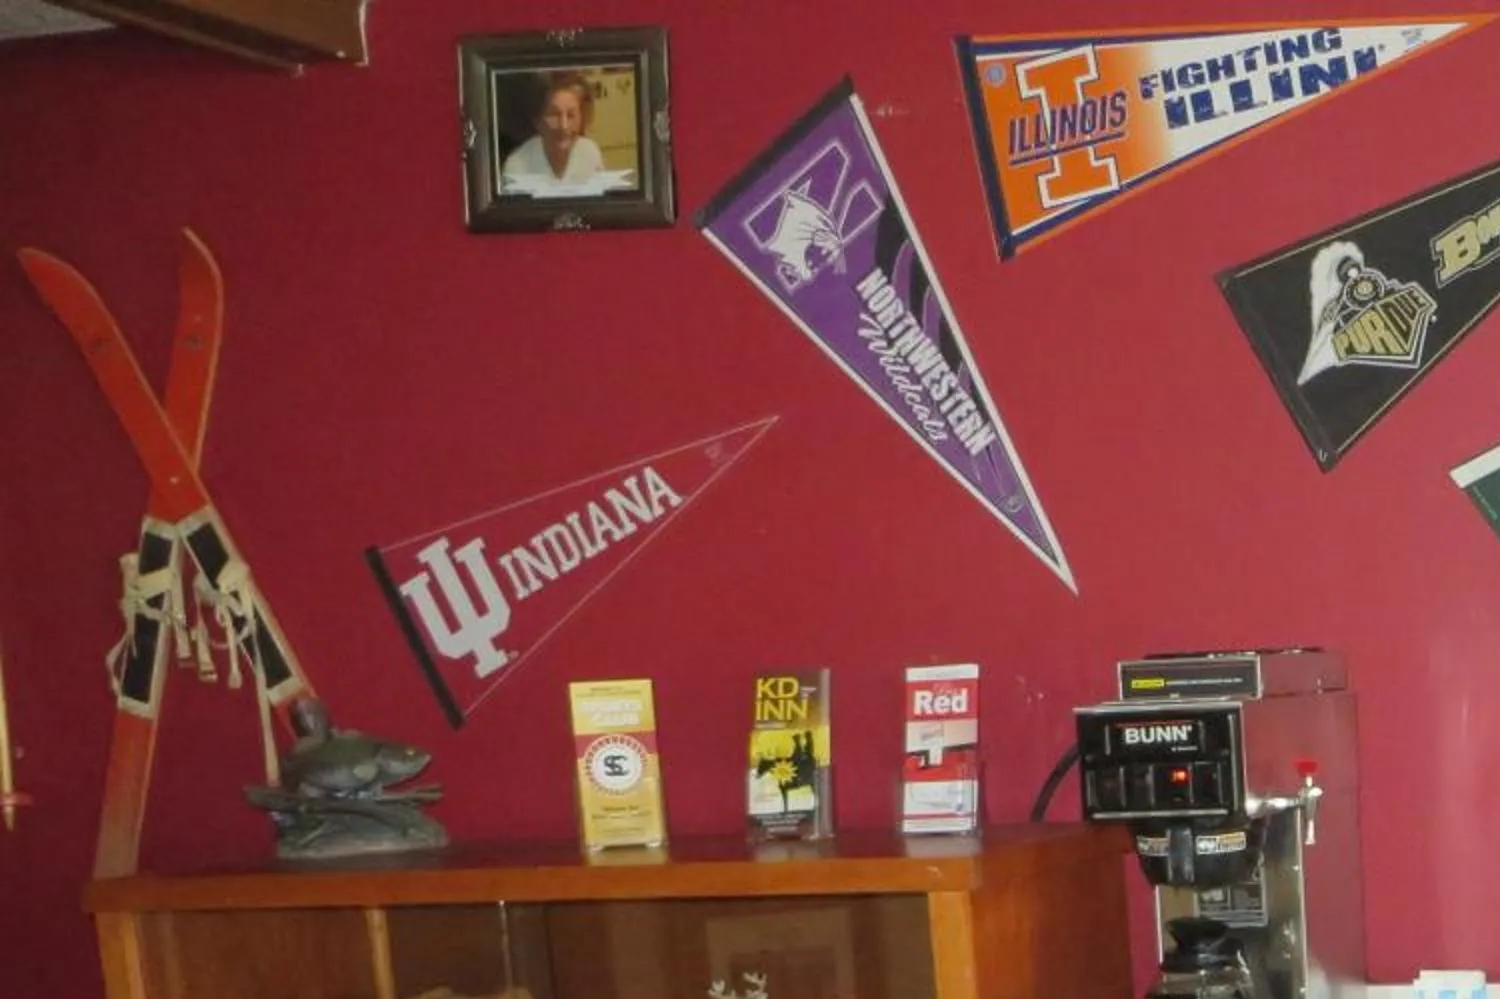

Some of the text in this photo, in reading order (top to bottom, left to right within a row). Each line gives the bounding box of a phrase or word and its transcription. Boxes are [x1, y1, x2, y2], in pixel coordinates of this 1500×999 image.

[1139, 27, 1344, 100] FIGHTING
[1161, 45, 1383, 131] ILLINI
[1007, 91, 1129, 157] ILLINOIS
[1334, 287, 1430, 360] PURDUE
[855, 268, 996, 457] NORTHWESTERN
[858, 312, 948, 446] Wildcats
[498, 466, 684, 600] INDIANA
[755, 677, 800, 698] KD
[755, 699, 808, 720] INN
[913, 688, 968, 716] Red
[1125, 726, 1188, 744] BUNN
